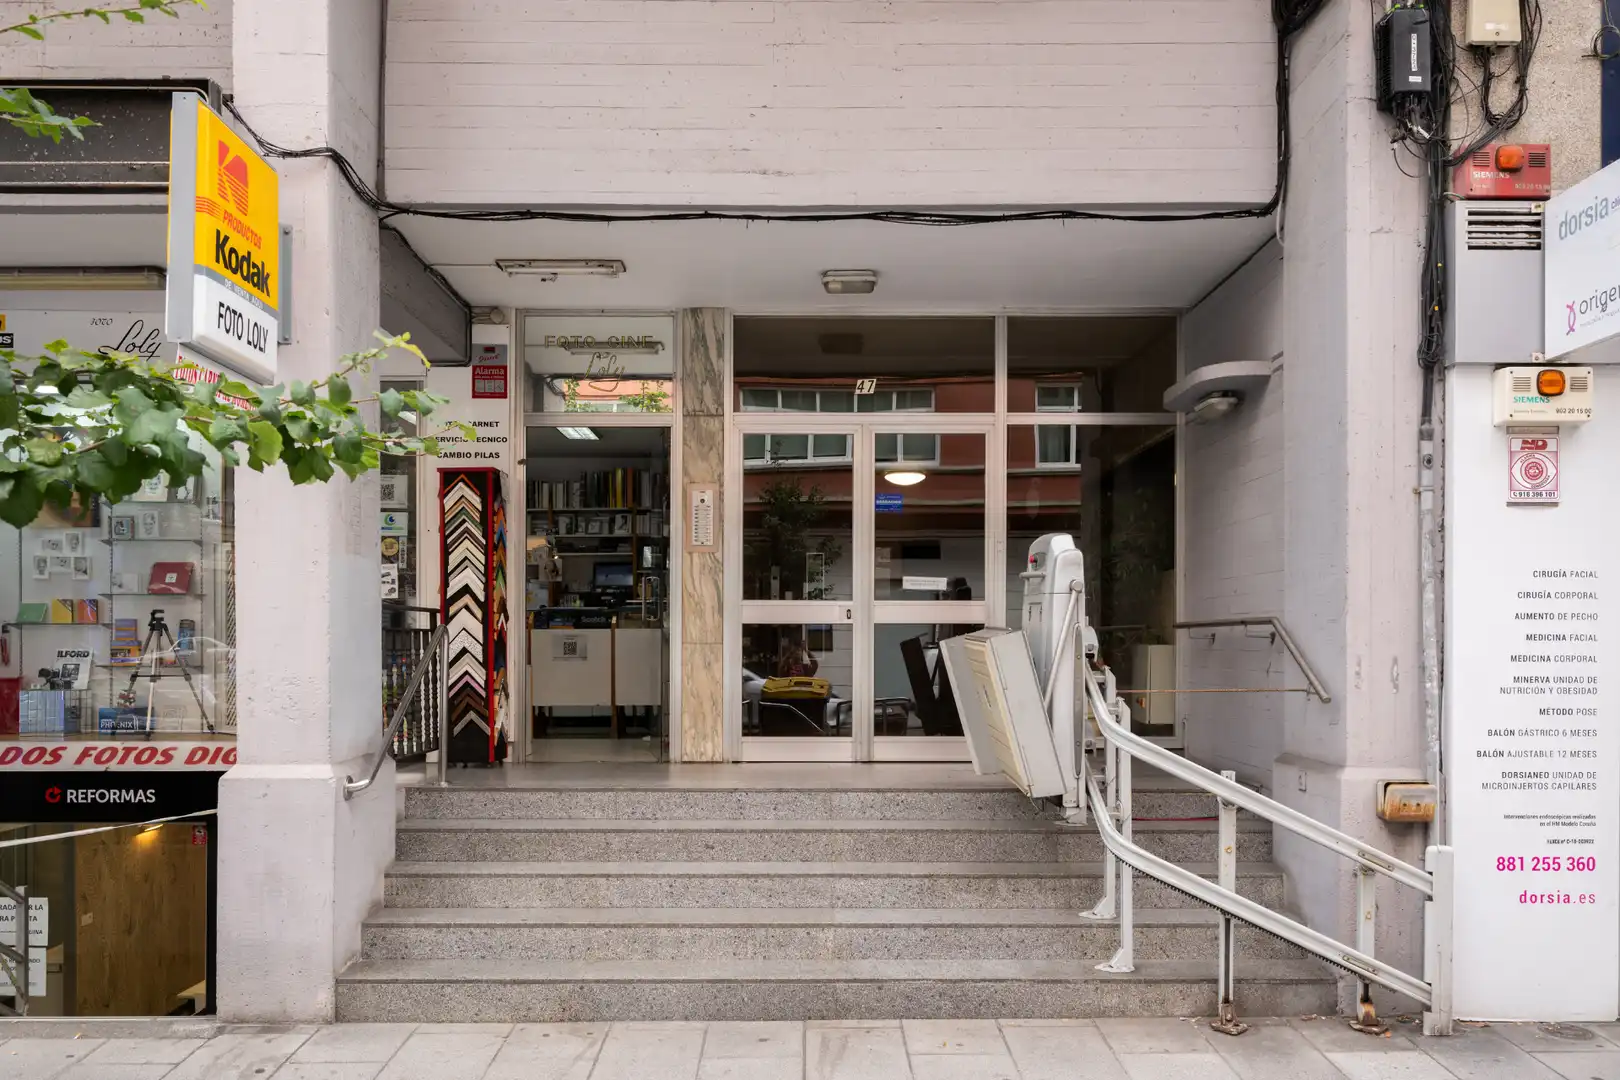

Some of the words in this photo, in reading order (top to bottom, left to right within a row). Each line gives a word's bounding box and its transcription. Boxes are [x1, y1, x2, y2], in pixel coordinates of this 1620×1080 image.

[1558, 195, 1609, 241] dorsia
[222, 209, 263, 250] PRODUCTOS
[215, 228, 271, 298] Kodak
[217, 301, 244, 341] FOTO
[246, 317, 269, 354] LOLY
[97, 319, 162, 362] Loly
[544, 335, 595, 348] FOTO
[608, 335, 653, 348] CINE
[475, 367, 504, 375] Alarma
[857, 380, 874, 393] 47
[1513, 396, 1550, 404] SIEMENS
[1533, 569, 1567, 578] CIRUGÍA
[1570, 570, 1598, 578] FACIAL
[1517, 590, 1552, 599] CIRUGÍA
[1554, 591, 1598, 599] CORPORAL
[1514, 612, 1555, 620] AUMENTO
[56, 650, 90, 659] ILFORD
[1554, 655, 1598, 663] CORPORAL
[1513, 676, 1550, 684] MINERVA
[1553, 676, 1584, 684] UNIDAD
[1587, 676, 1598, 684] DE
[1499, 686, 1546, 694] NUTRICIÓN
[1556, 687, 1598, 695] OBESIDAD
[1539, 707, 1573, 715] MÉTODO
[1576, 708, 1597, 716] POSE
[1487, 728, 1515, 737] BALÓN
[1518, 728, 1560, 737] GÁSTRICO
[1562, 729, 1567, 737] 6
[1570, 729, 1597, 737] MESES
[0, 746, 68, 766] DOS
[74, 746, 178, 766] FOTOS
[184, 746, 237, 766] DIG
[1476, 749, 1504, 758] BALÓN
[1507, 750, 1554, 758] AJUSTABLE
[1558, 750, 1567, 758] 12
[1570, 750, 1597, 758] MESES
[1501, 771, 1549, 779] DORSIANEO
[1552, 771, 1584, 779] UNIDAD
[1481, 782, 1549, 790] MICROINJERTOS
[1551, 782, 1597, 790] CAPILARES
[66, 788, 156, 804] REFORMAS
[1496, 856, 1524, 872] 881
[1531, 856, 1561, 872] 255
[1566, 856, 1596, 872] 360
[1519, 890, 1596, 904] dorsia.es
